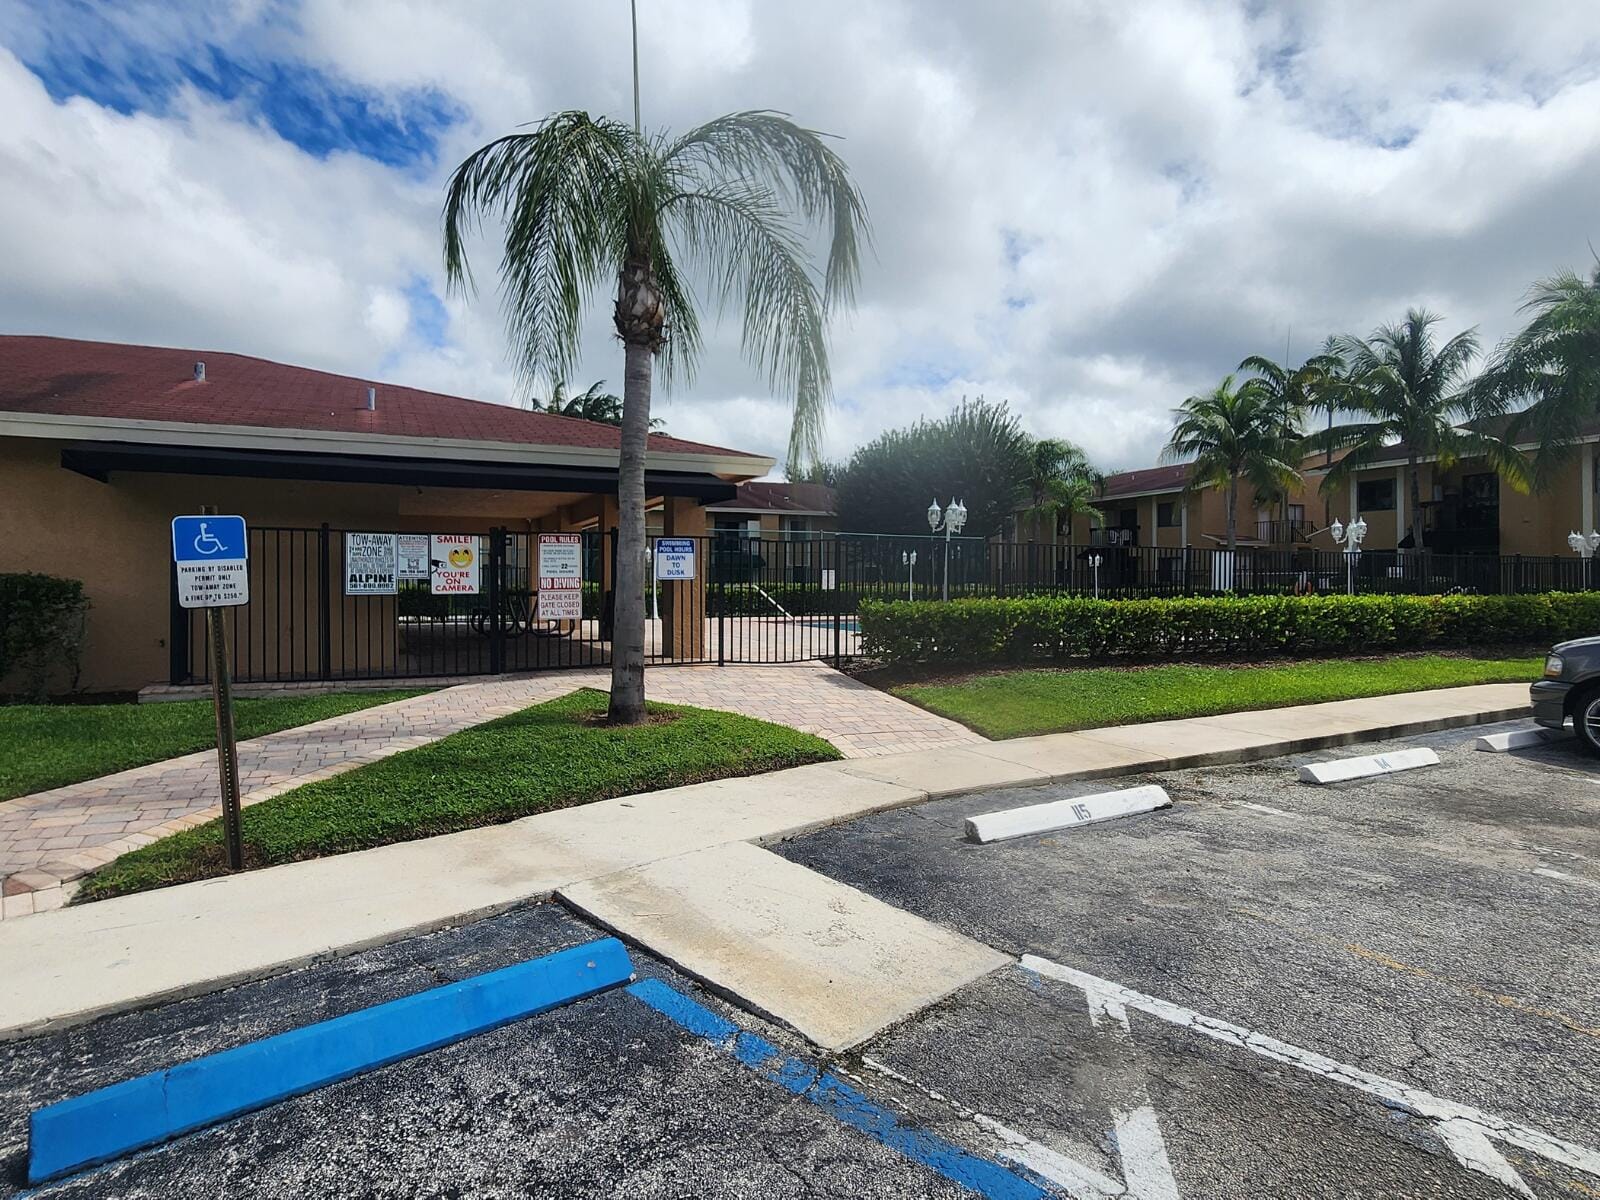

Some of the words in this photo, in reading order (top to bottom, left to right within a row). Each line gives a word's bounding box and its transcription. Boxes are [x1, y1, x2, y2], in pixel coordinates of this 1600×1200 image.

[352, 534, 392, 546] TOW-AWAY
[436, 536, 473, 544] SMILE!
[362, 546, 382, 556] ZONE
[350, 574, 394, 582] ALPINE
[541, 578, 552, 588] NO
[554, 578, 580, 588] DIVING
[1071, 804, 1092, 820] 115
